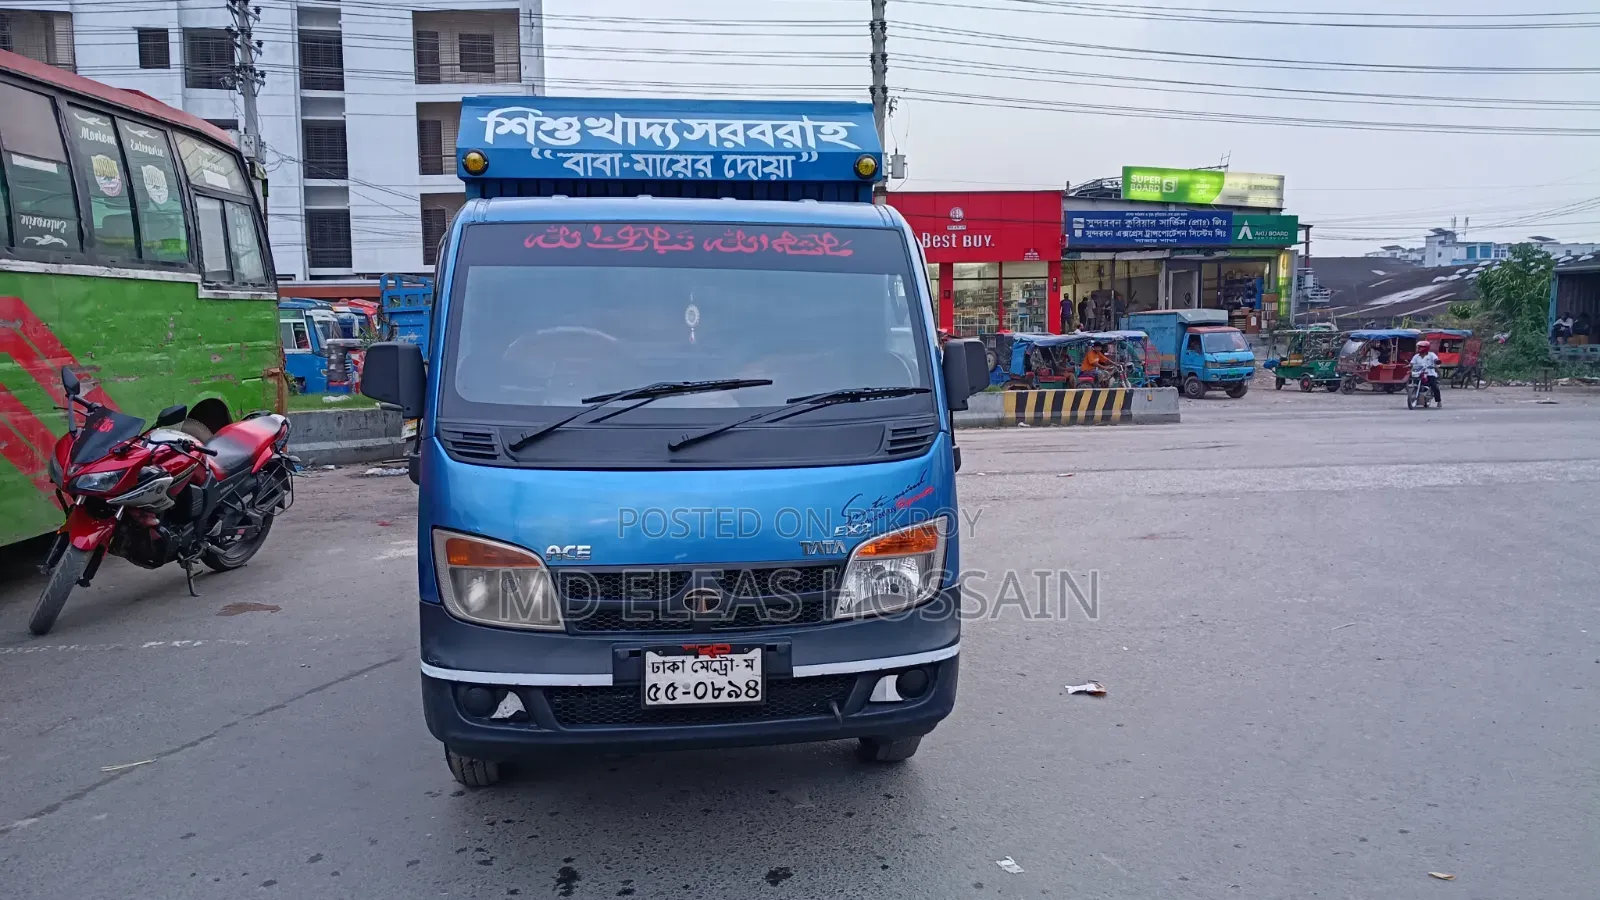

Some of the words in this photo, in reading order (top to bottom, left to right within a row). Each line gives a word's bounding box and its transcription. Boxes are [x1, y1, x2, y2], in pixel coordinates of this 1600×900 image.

[477, 106, 582, 147] শিশু
[1130, 174, 1161, 184] SUPER
[1130, 183, 1160, 193] BOARD
[922, 232, 957, 248] Best
[546, 544, 591, 561] ACE
[799, 540, 847, 555] TATA
[651, 658, 686, 675] ঢাকা
[647, 679, 760, 702] ৫৫-০৮৯৪
